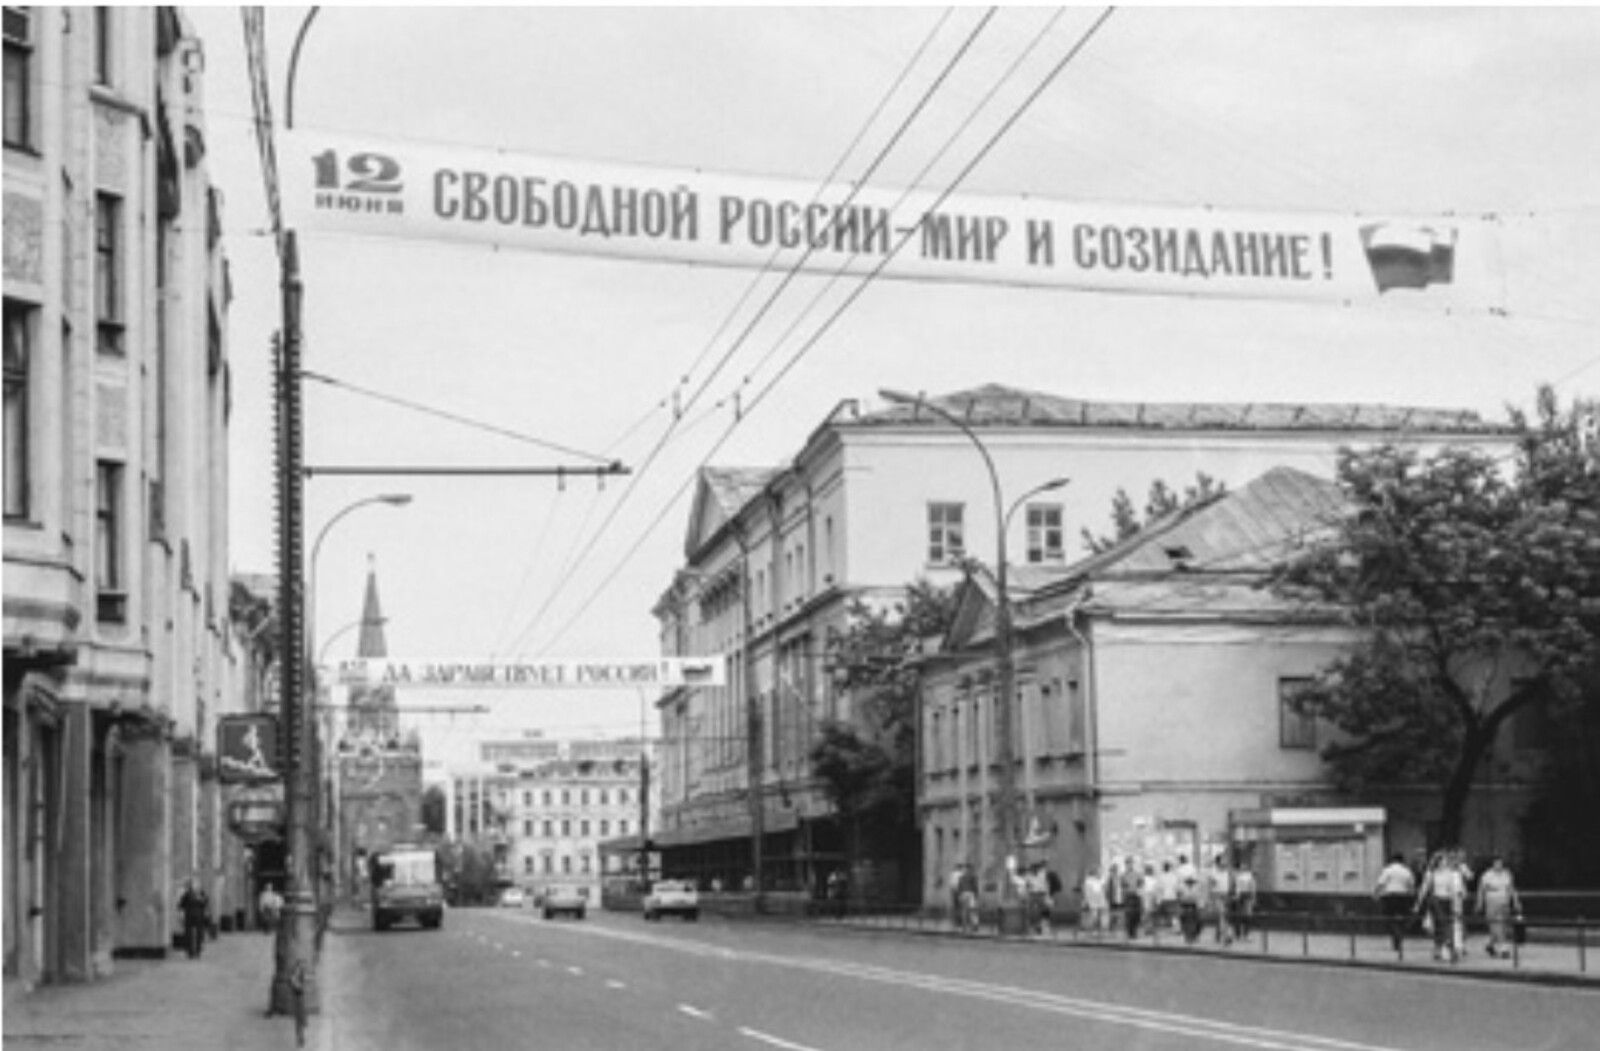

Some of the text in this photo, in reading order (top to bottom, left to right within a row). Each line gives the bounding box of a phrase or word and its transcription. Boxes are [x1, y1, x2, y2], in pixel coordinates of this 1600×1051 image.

[311, 149, 404, 193] 12
[433, 168, 699, 240] СВОБОДНОЙ
[1027, 219, 1055, 266] И
[1072, 222, 1333, 280] СОЗИДАНИЕ!
